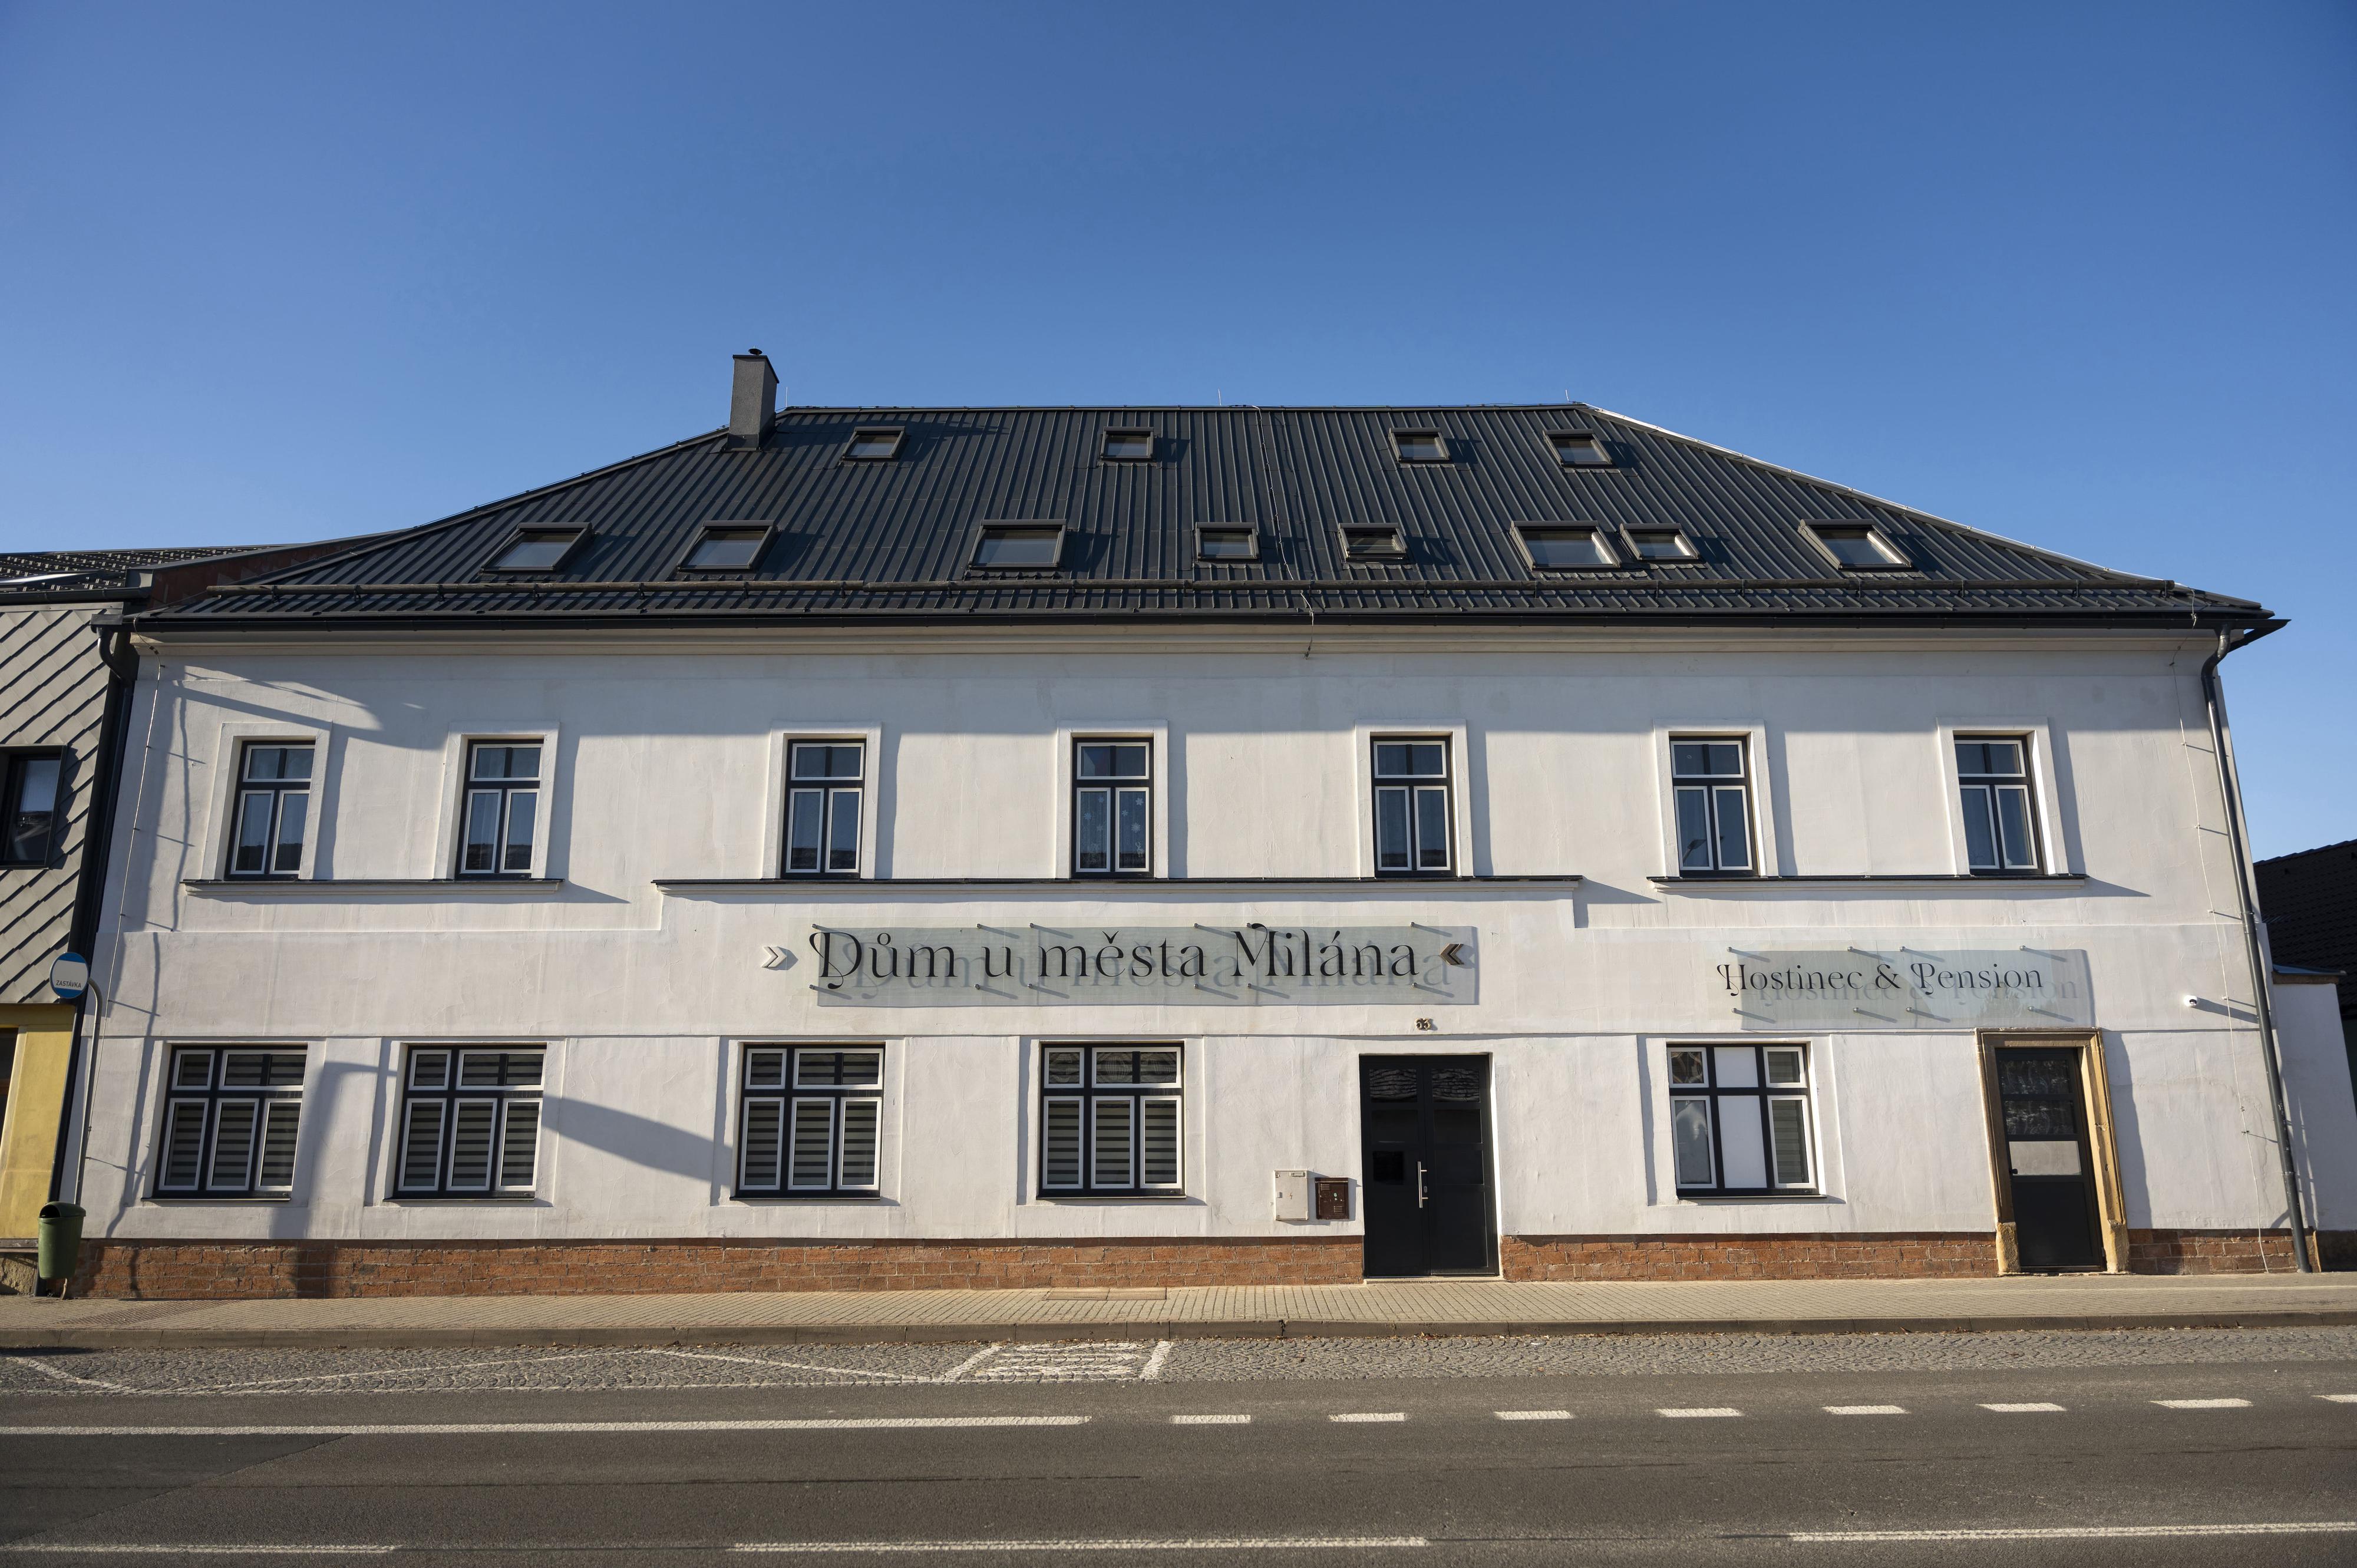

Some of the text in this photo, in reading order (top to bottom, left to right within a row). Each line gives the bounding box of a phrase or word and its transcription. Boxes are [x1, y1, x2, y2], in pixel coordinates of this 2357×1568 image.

[809, 922, 1420, 989] Dům u města Milána
[56, 980, 82, 988] ZASTÁVKA
[1716, 962, 2044, 996] Hostinec & Pension
